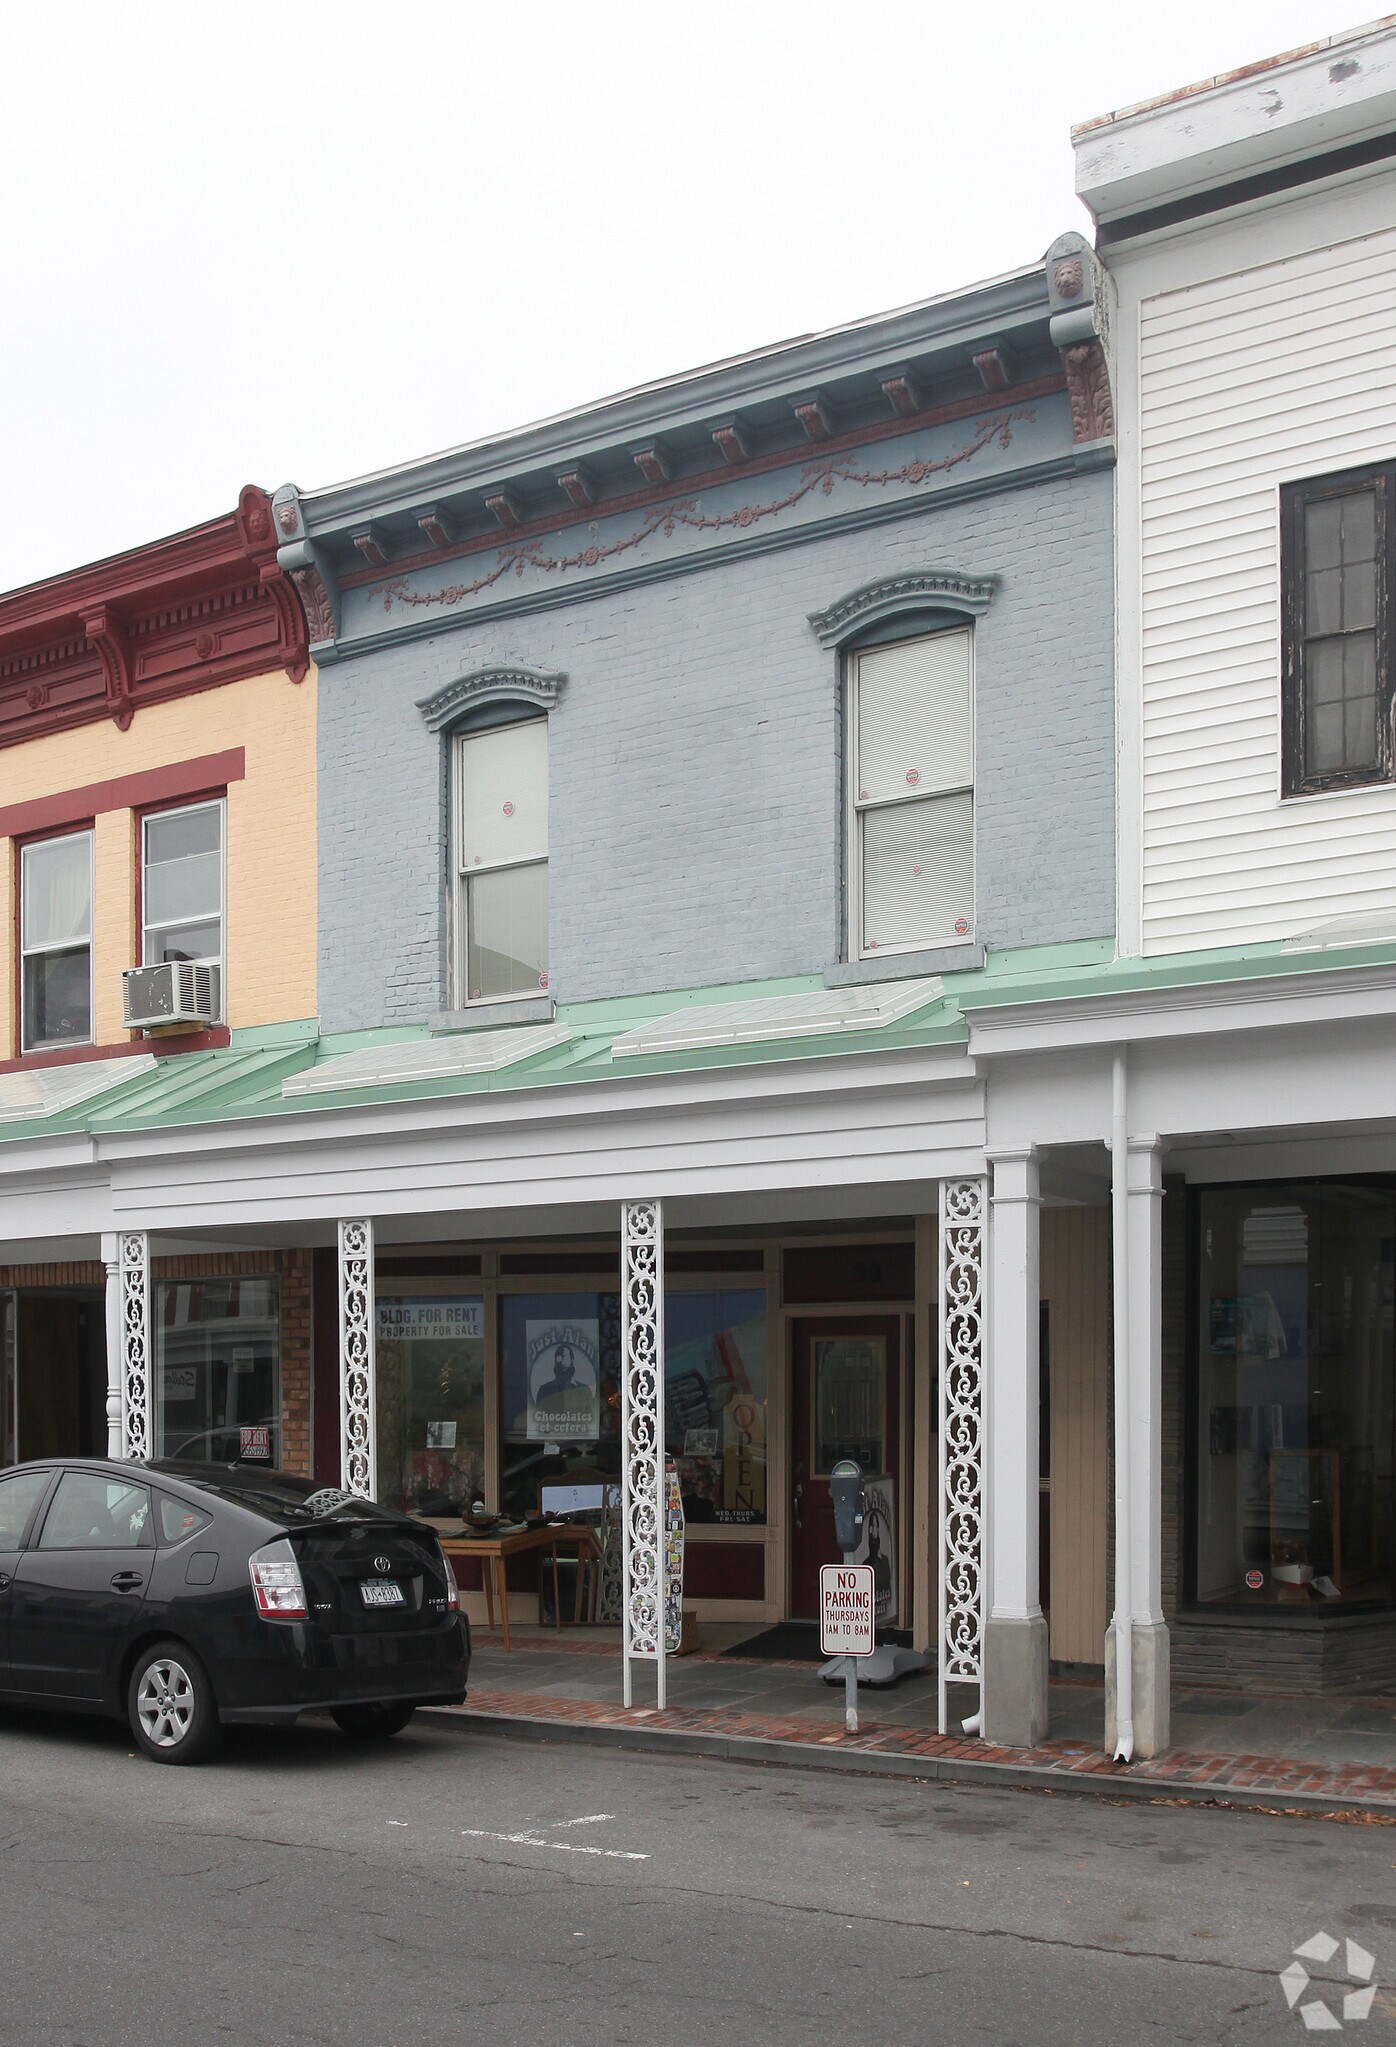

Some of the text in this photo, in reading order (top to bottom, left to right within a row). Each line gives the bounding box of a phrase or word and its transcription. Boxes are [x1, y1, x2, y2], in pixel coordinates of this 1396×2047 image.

[380, 1307, 478, 1324] BLDG. FOR RENT
[380, 1324, 479, 1337] PROPERTY FOR SALE
[534, 1410, 593, 1422] Chocolates
[733, 1404, 755, 1511] OPEN
[837, 1572, 857, 1589] NO
[825, 1591, 869, 1608] PARKING
[825, 1610, 869, 1622] THURSDAYS
[825, 1624, 869, 1635] 1AM TO 8AM
